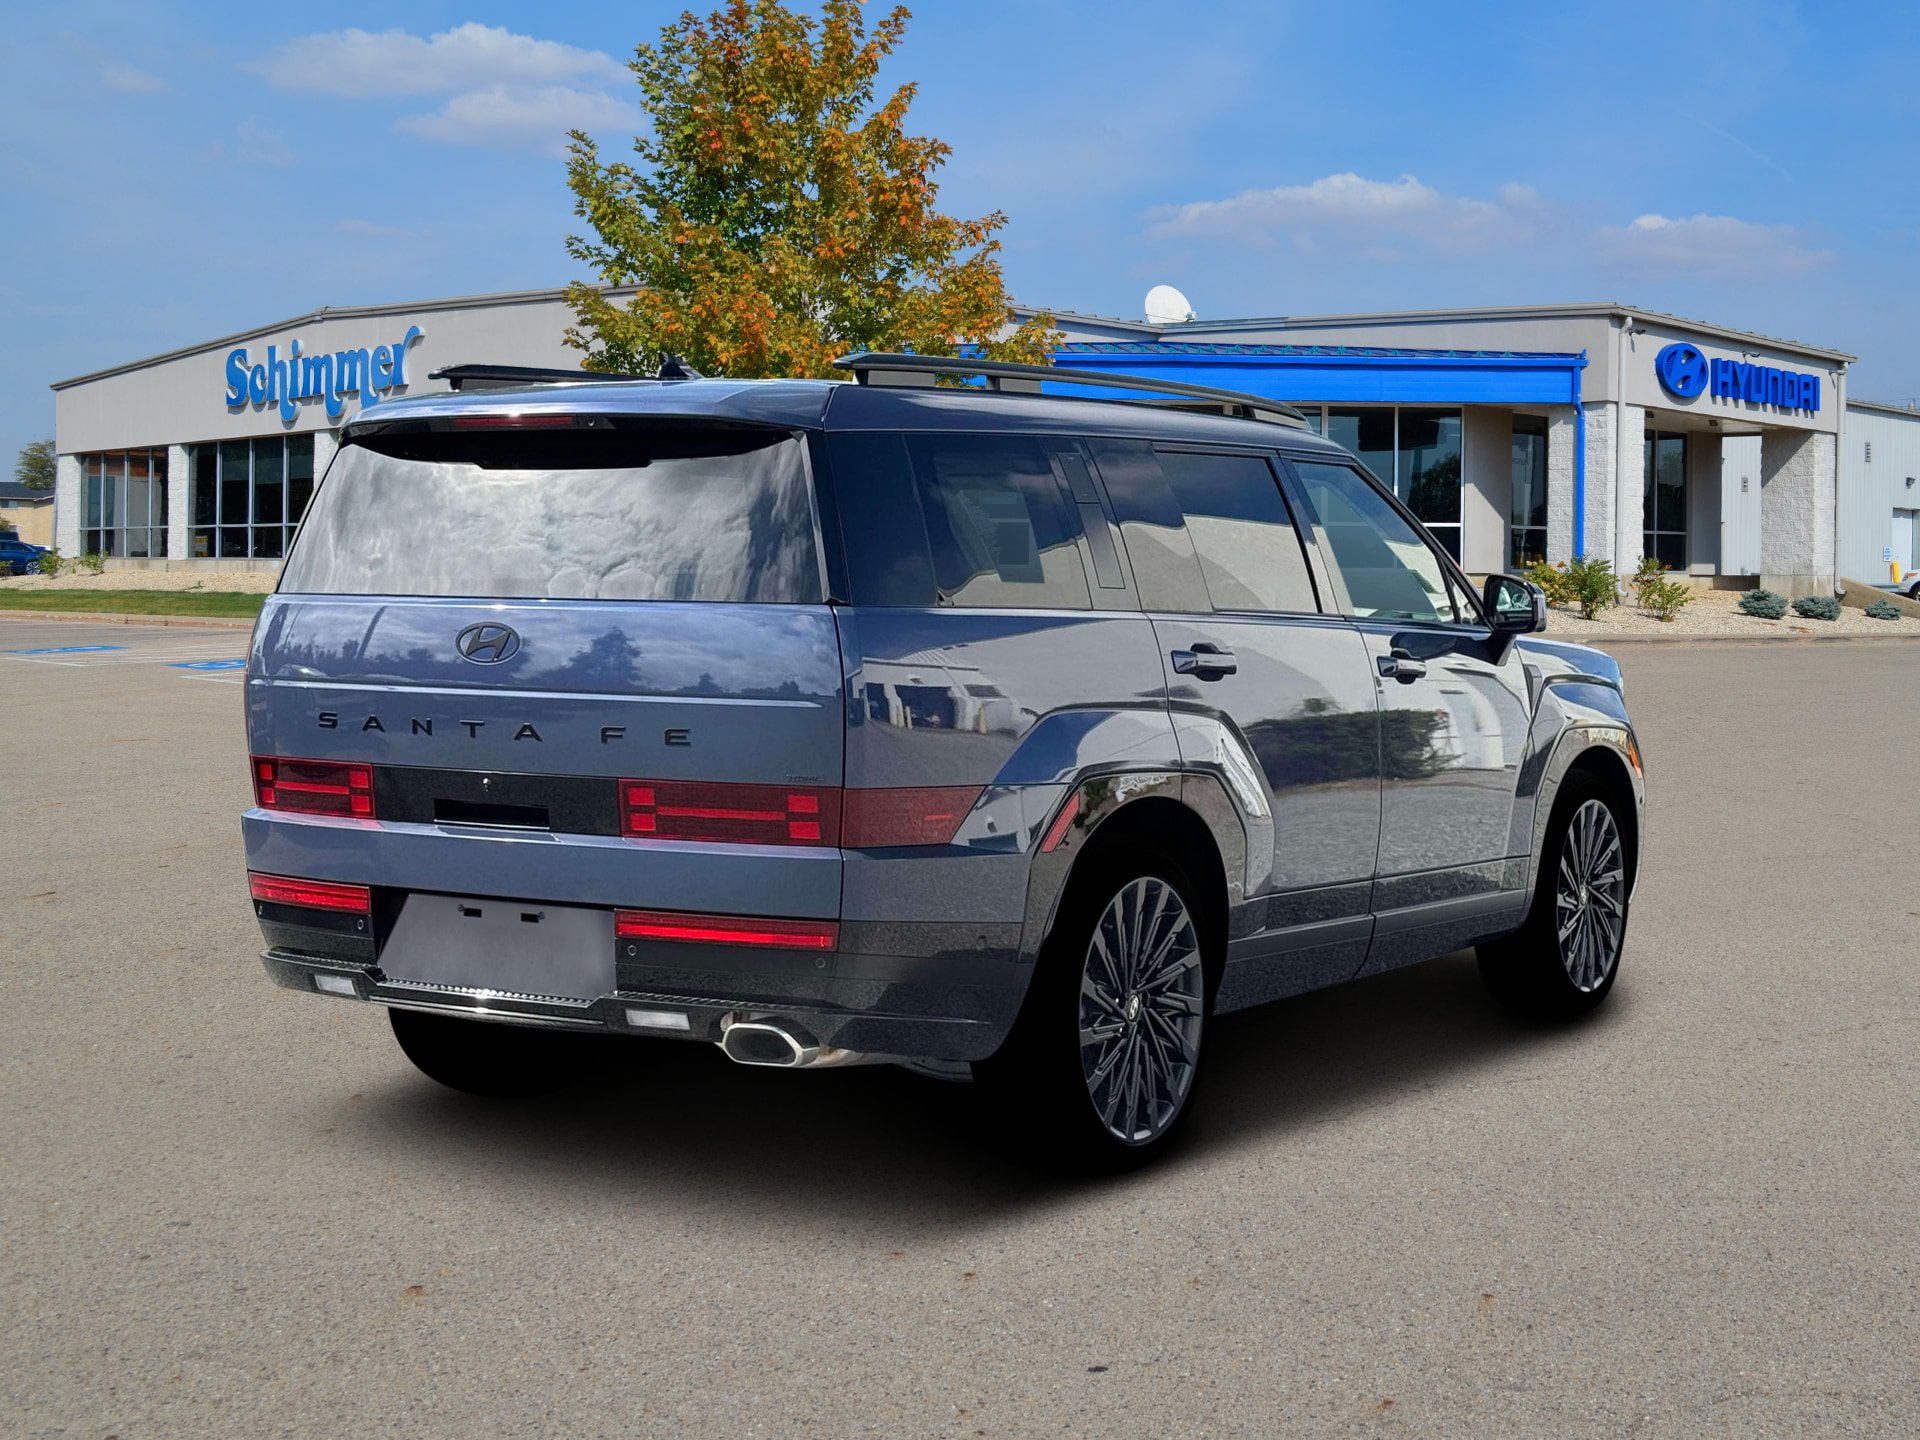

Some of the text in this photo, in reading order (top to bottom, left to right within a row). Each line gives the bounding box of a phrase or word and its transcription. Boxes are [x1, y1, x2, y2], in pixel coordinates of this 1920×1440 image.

[225, 325, 425, 422] Schimmer
[1710, 358, 1820, 411] HYUNDAI
[318, 711, 692, 746] SANTA FE
